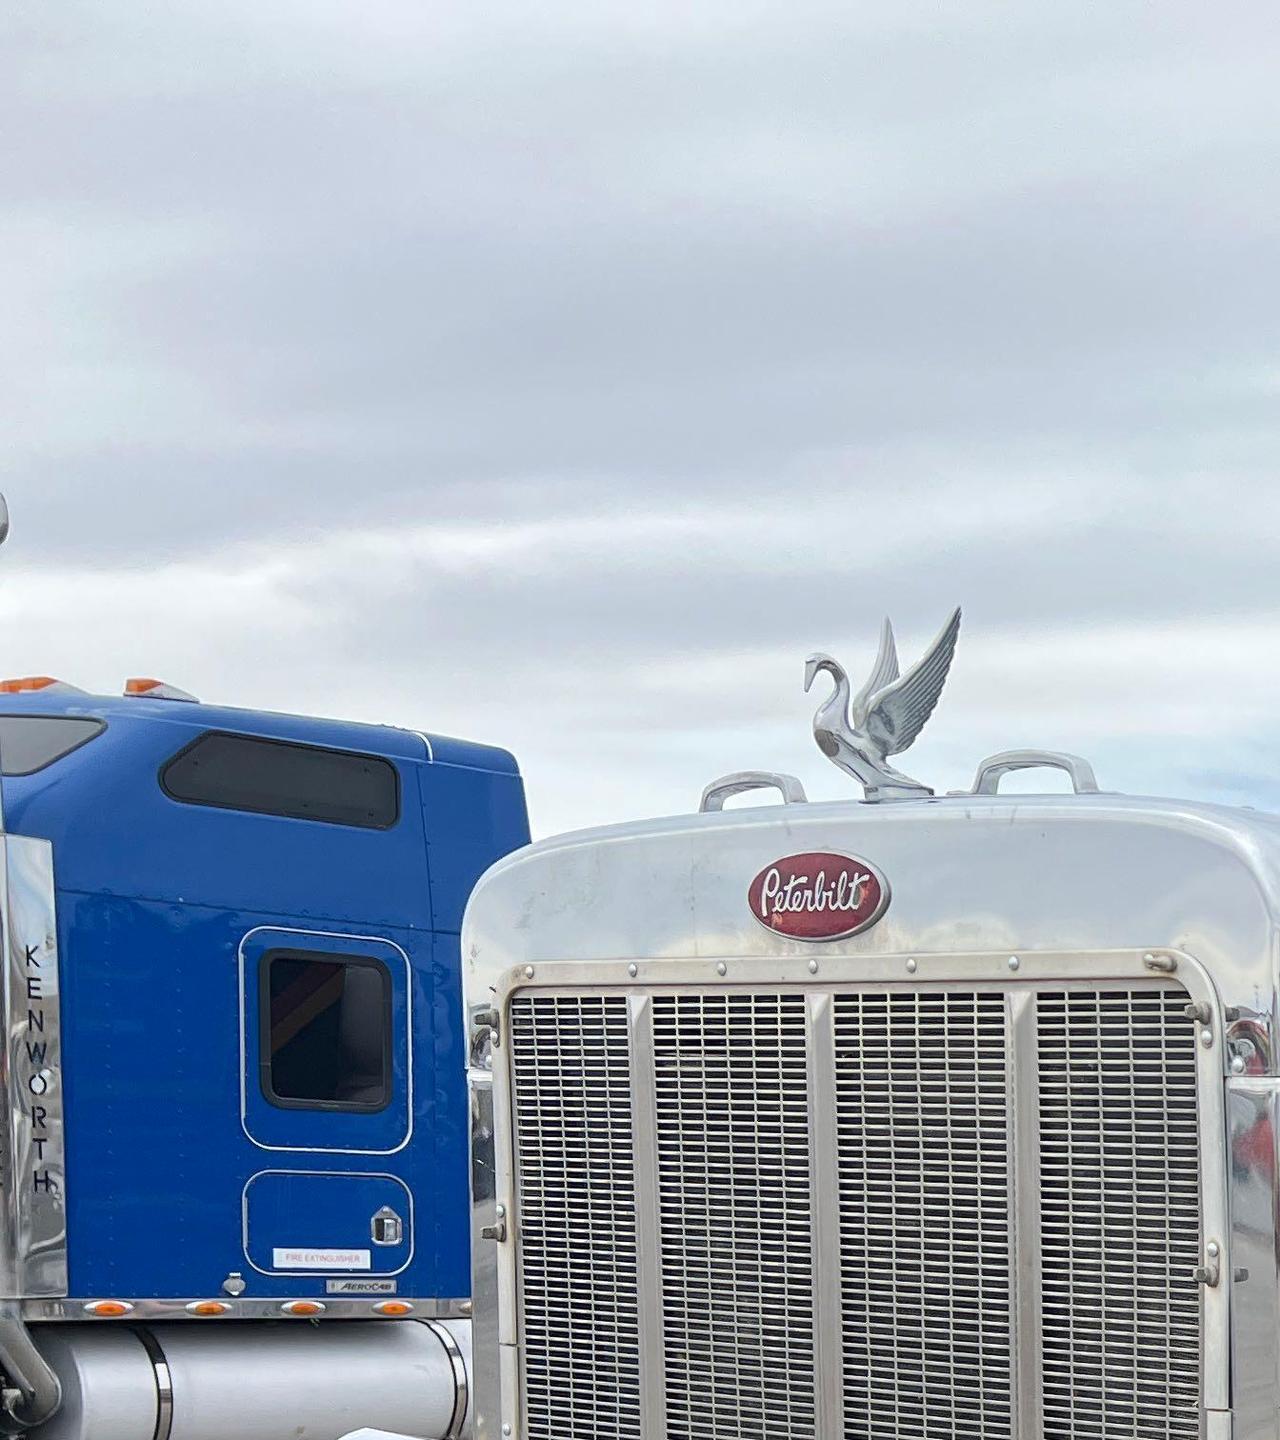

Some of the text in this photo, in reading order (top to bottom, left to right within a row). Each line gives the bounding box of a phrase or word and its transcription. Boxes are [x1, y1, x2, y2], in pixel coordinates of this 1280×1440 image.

[760, 868, 870, 917] Peterbilt
[25, 944, 50, 1193] KENWORTH
[286, 1253, 303, 1263] FIRE
